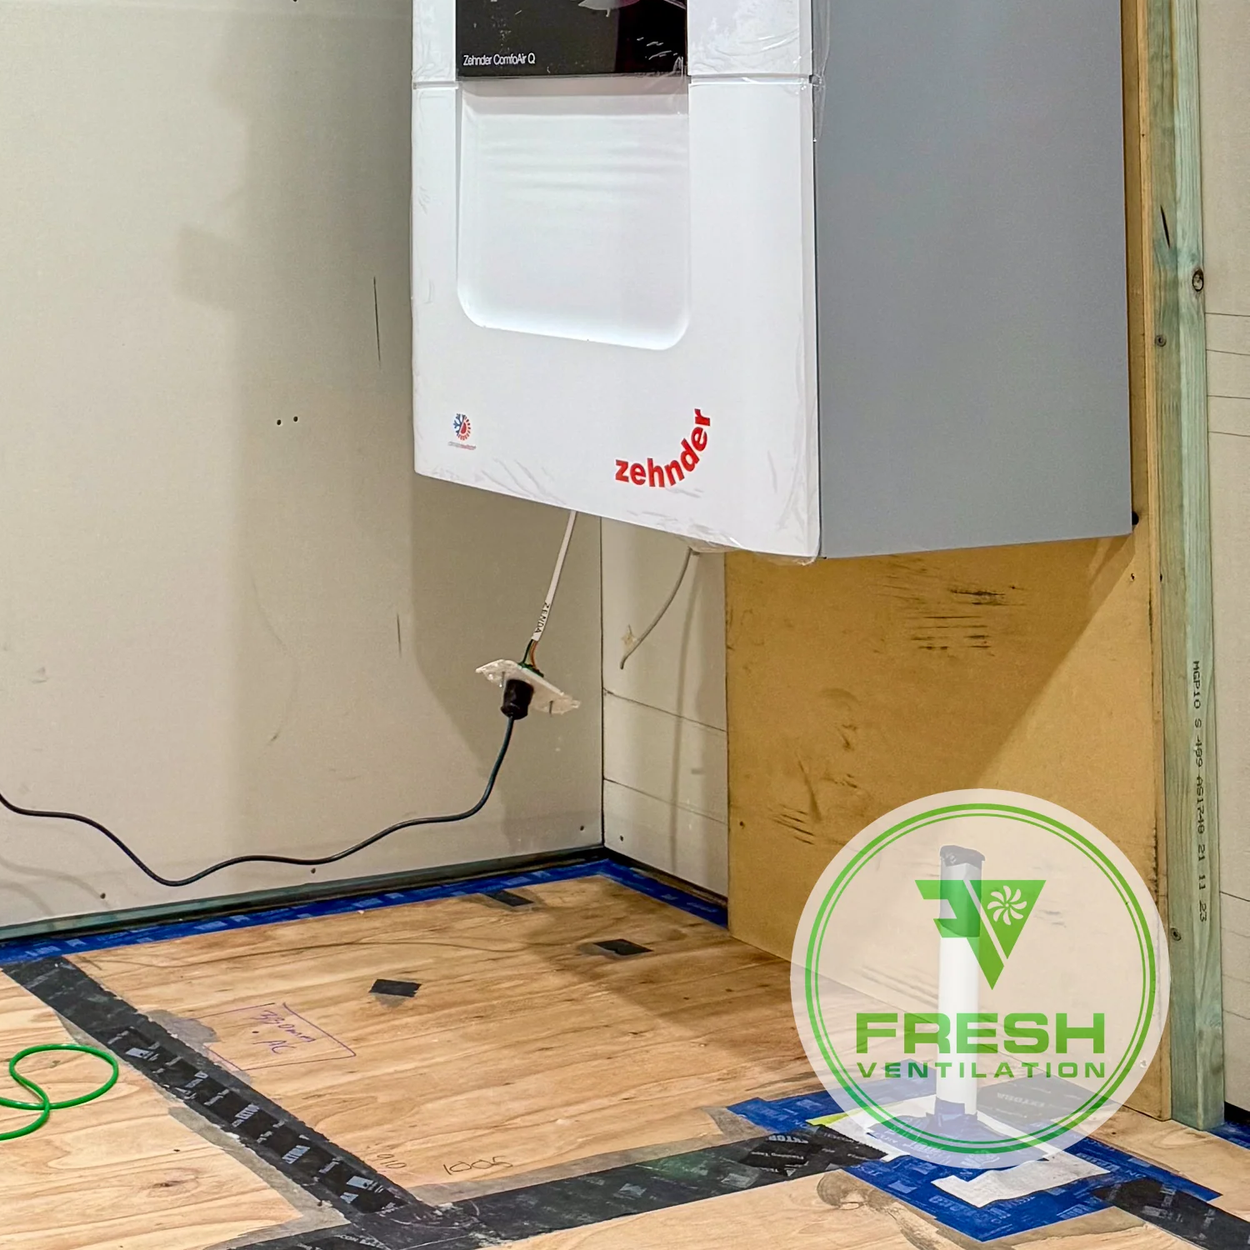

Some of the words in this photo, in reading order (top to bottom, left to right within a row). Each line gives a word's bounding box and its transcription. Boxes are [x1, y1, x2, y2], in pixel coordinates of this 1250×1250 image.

[463, 55, 492, 66] Zehnder
[493, 53, 527, 65] ComfoAir
[527, 52, 536, 65] Q
[615, 408, 712, 488] zehnder
[1193, 660, 1201, 710] MGP10
[1197, 844, 1206, 861] 21
[1198, 875, 1206, 891] 11
[1198, 903, 1207, 922] 23
[443, 1155, 514, 1176] 1005
